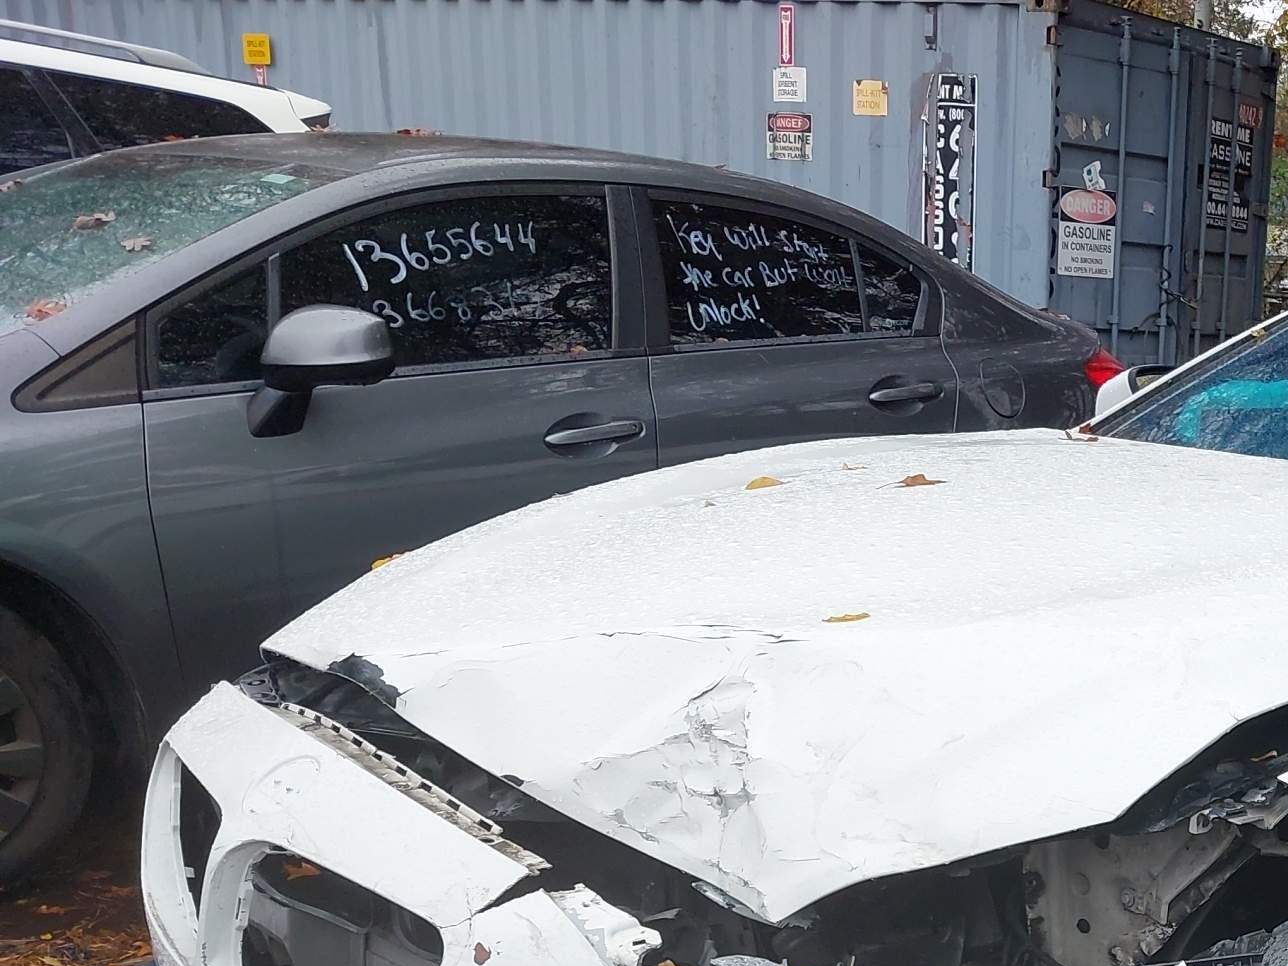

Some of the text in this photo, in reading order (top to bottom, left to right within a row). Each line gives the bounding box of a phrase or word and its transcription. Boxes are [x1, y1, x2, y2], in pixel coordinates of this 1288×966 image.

[1236, 127, 1251, 143] ME
[1066, 196, 1110, 215] DANGER
[666, 214, 722, 261] Key
[1063, 225, 1112, 241] GASOLINE
[1061, 241, 1112, 254] IN CONTAINERS
[343, 221, 536, 292] 13655644
